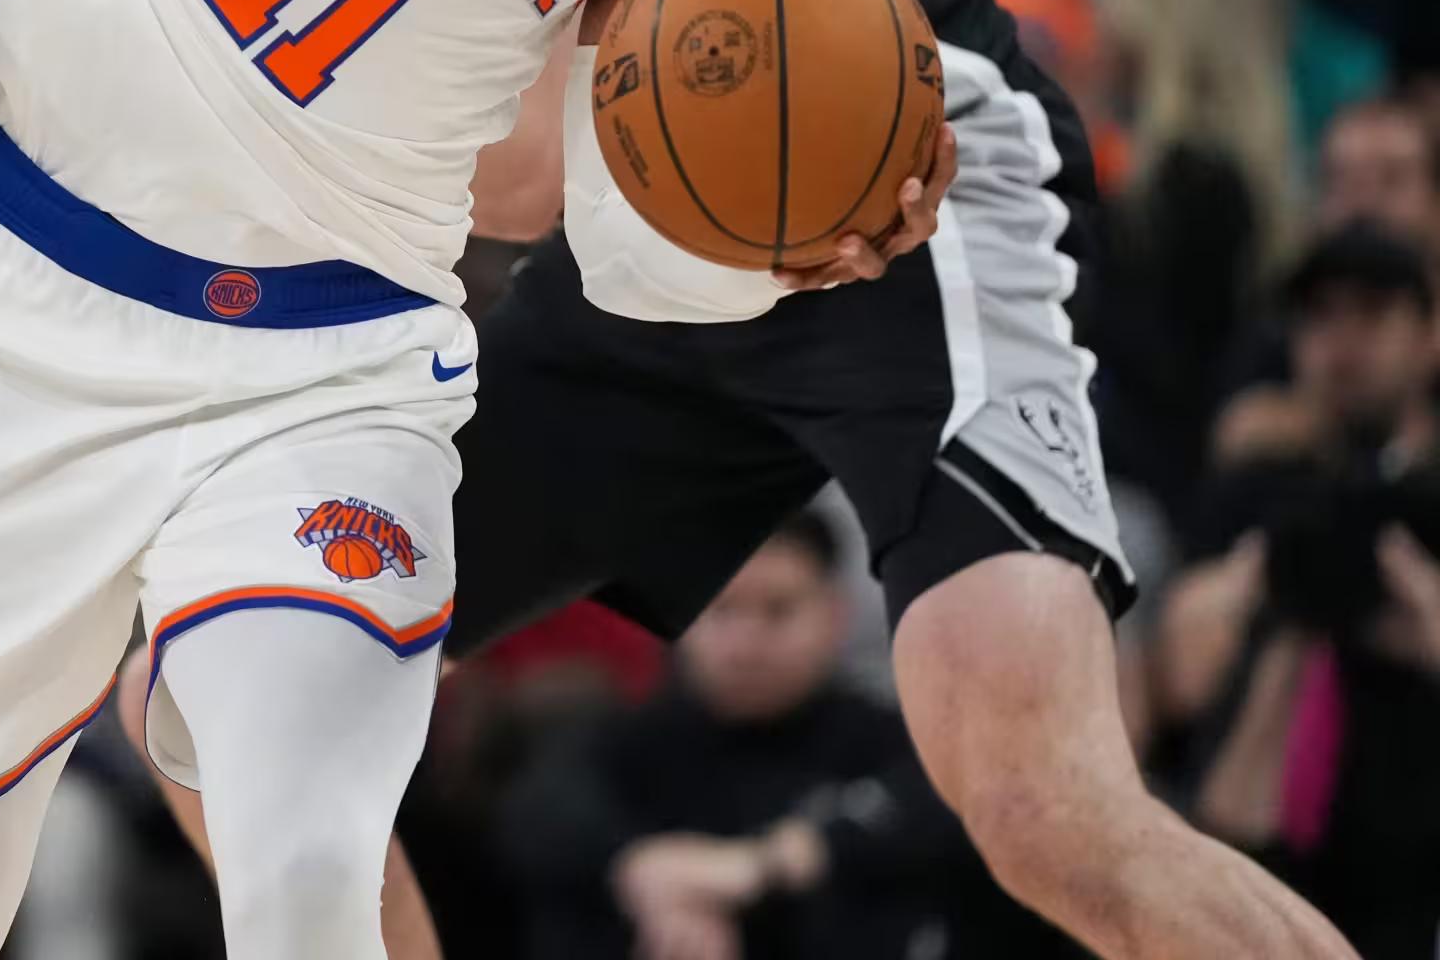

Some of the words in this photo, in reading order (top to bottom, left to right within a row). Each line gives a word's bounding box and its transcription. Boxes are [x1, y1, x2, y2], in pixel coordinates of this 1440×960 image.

[344, 497, 369, 508] NEW
[370, 504, 395, 524] YORK
[294, 499, 416, 578] KNICKS
